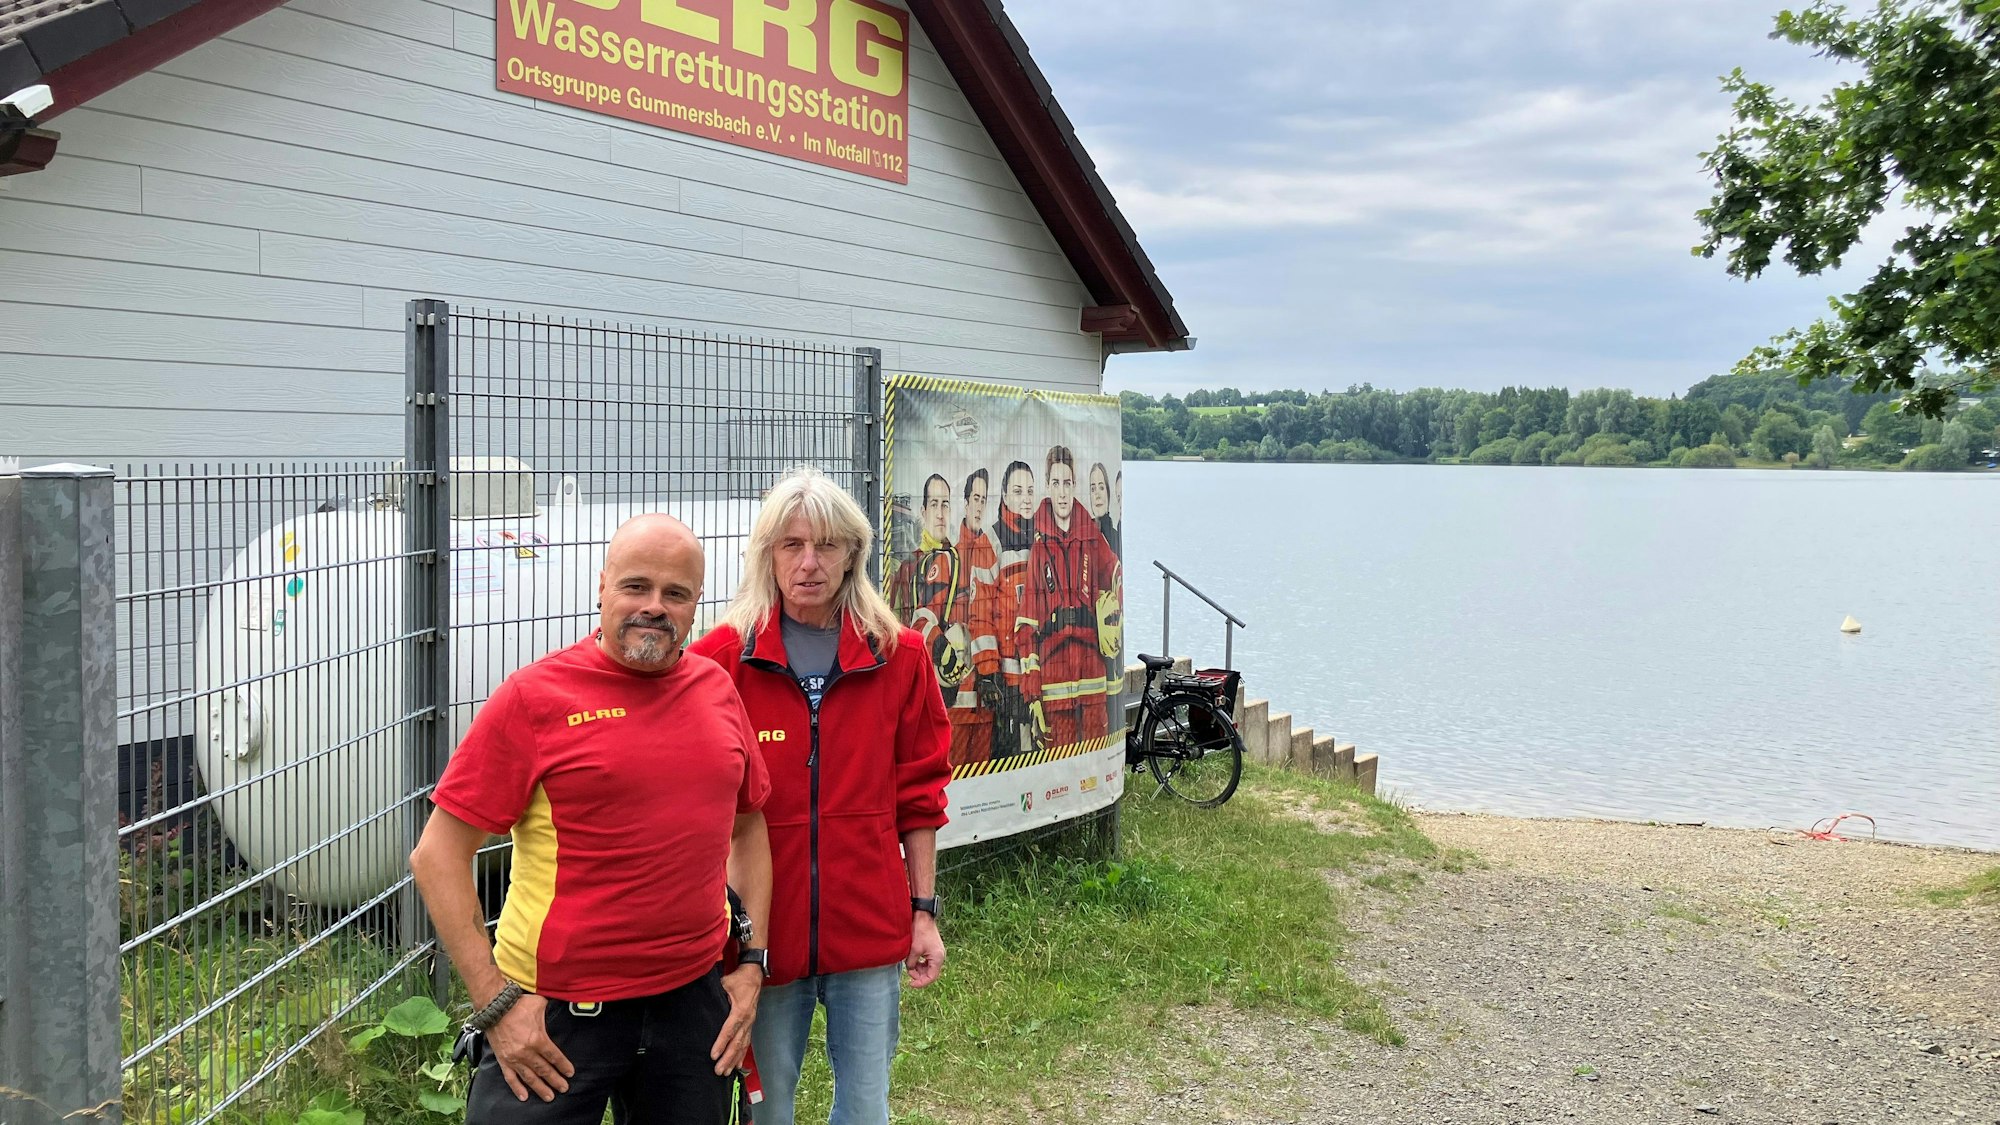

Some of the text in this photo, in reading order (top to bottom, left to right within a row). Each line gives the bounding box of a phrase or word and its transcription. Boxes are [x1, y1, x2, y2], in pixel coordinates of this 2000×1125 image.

[507, 57, 903, 173] Ortsgruppe Gummersbach e.V. Im Notfall 112
[509, 0, 903, 141] Wasserrettungsstation
[567, 707, 627, 727] DLRG
